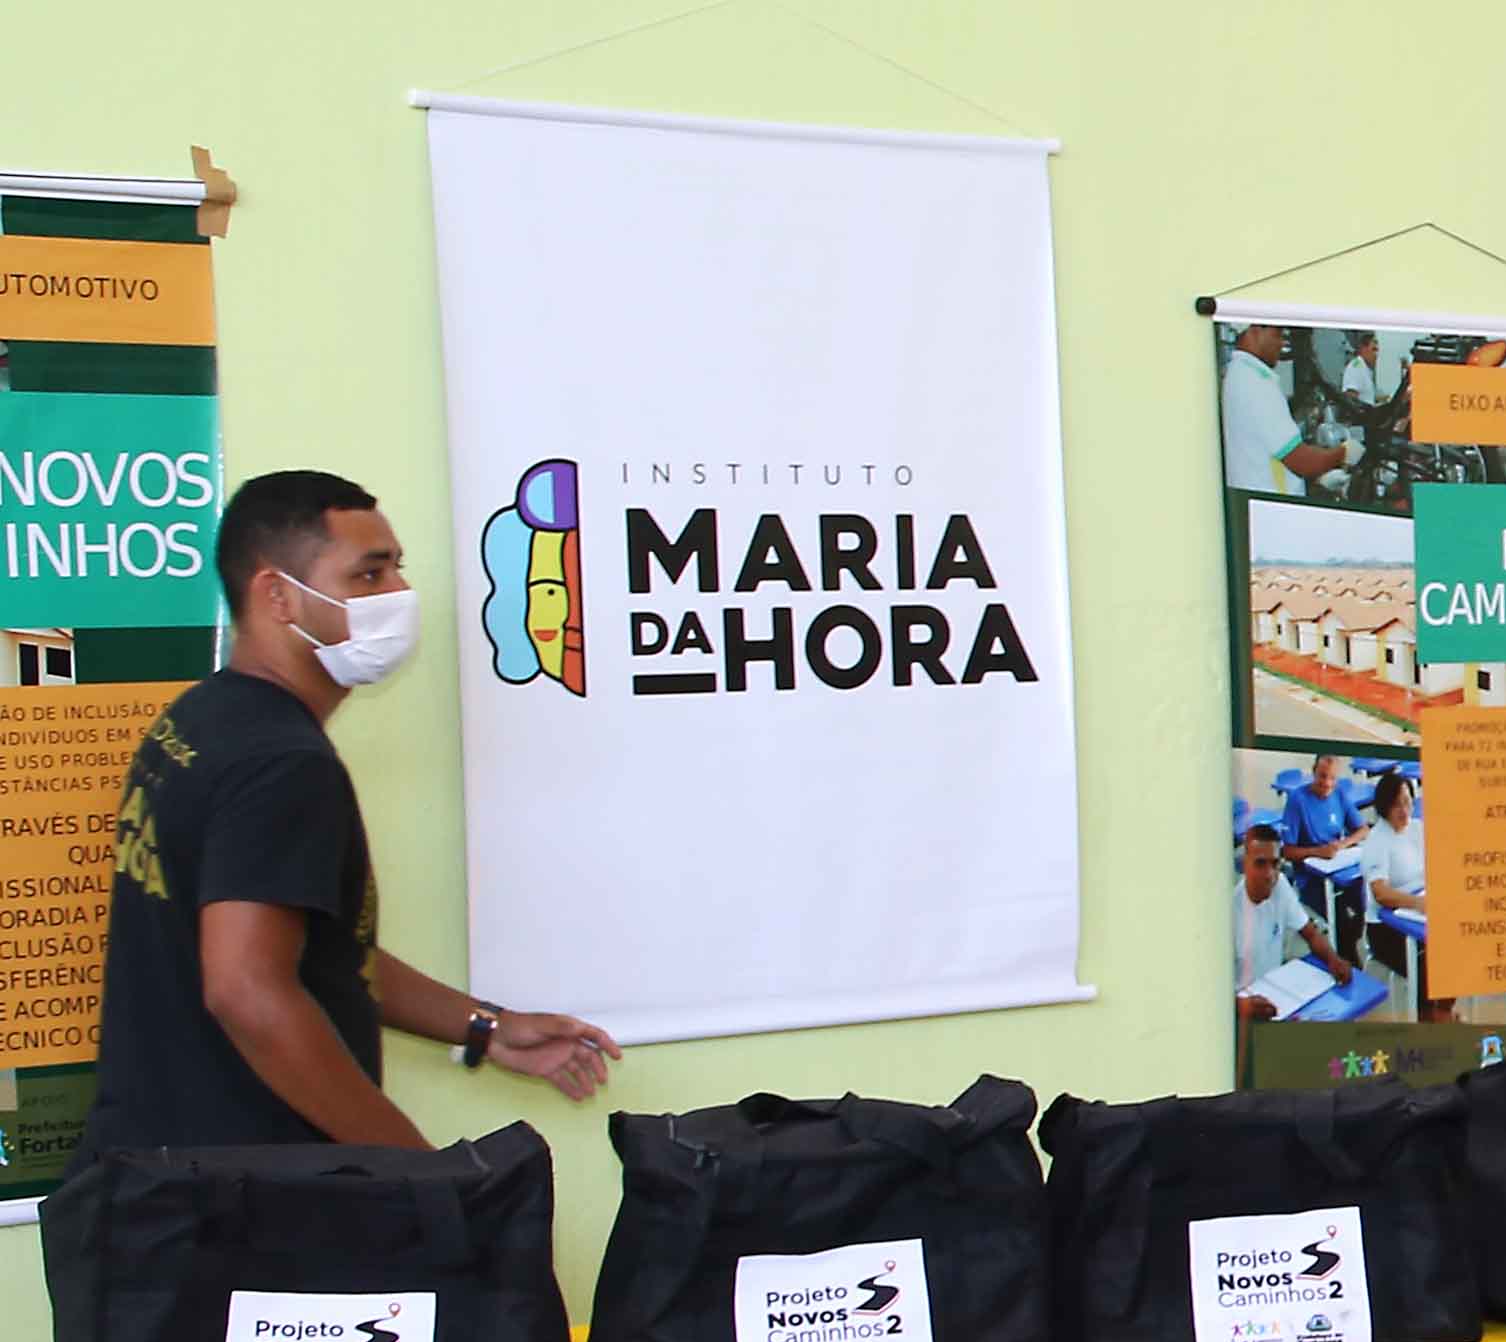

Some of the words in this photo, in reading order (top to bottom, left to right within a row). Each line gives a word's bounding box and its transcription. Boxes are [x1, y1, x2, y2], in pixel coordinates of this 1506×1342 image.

[1449, 393, 1490, 412] EIXO
[622, 462, 915, 487] INSTITUTO
[6, 522, 203, 579] INHOS
[625, 507, 998, 594] MARIA
[629, 610, 715, 657] DA
[721, 602, 1040, 693] HORA
[32, 706, 57, 721] DE
[63, 701, 156, 720] INCLUSÃO
[106, 727, 131, 742] EM
[14, 755, 54, 770] USO
[87, 814, 117, 834] DE
[1217, 1249, 1292, 1269] Projeto
[1218, 1272, 1293, 1291] Novos
[766, 1287, 848, 1307] Projeto
[1218, 1287, 1327, 1308] Caminhos
[1329, 1280, 1344, 1299] 2
[767, 1308, 848, 1329] Novos
[886, 1315, 902, 1335] 2
[255, 1320, 344, 1340] Projeto
